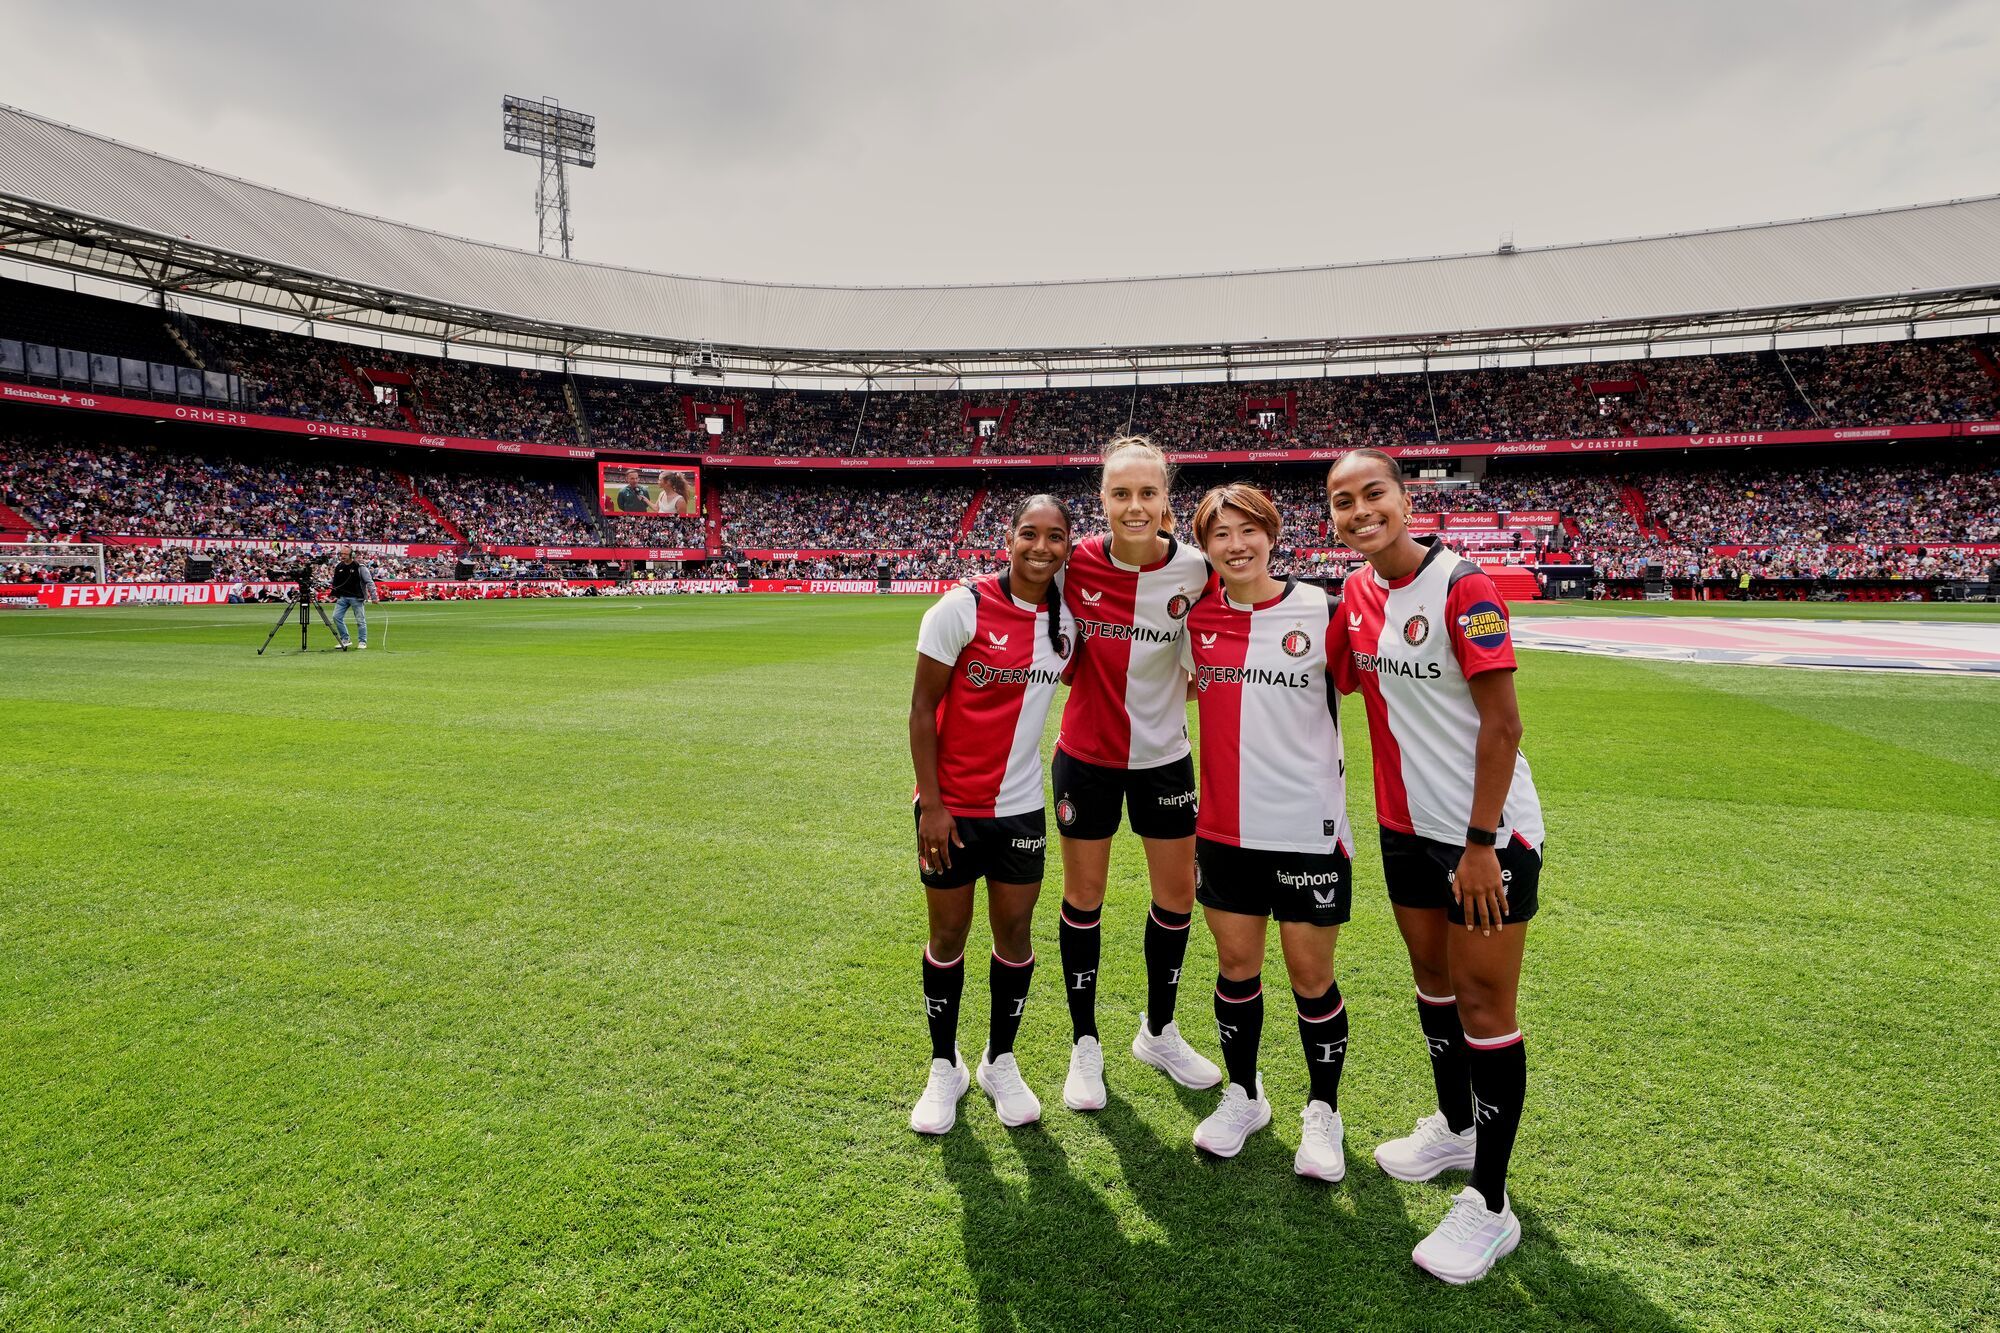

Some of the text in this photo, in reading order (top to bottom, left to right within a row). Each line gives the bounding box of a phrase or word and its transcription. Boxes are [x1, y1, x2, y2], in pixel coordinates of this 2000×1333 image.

[4, 387, 56, 401] Heineken
[175, 407, 237, 424] ORMER
[307, 423, 359, 437] ORMER
[1588, 439, 1639, 449] CASTORE
[1708, 434, 1764, 445] CASTORE
[569, 449, 596, 458] univé
[706, 455, 733, 464] Quooker
[774, 458, 800, 466] Quooker
[840, 459, 869, 467] fairphone
[906, 458, 935, 466] fairphone
[773, 551, 798, 560] univé
[810, 581, 873, 594] FEYENOORD
[61, 585, 210, 606] FEYENOORD
[1471, 612, 1498, 625] EURO
[1465, 621, 1506, 638] JACKPOT
[1276, 870, 1339, 890] fairphone
[1072, 969, 1096, 990] F
[1316, 1037, 1348, 1063] F
